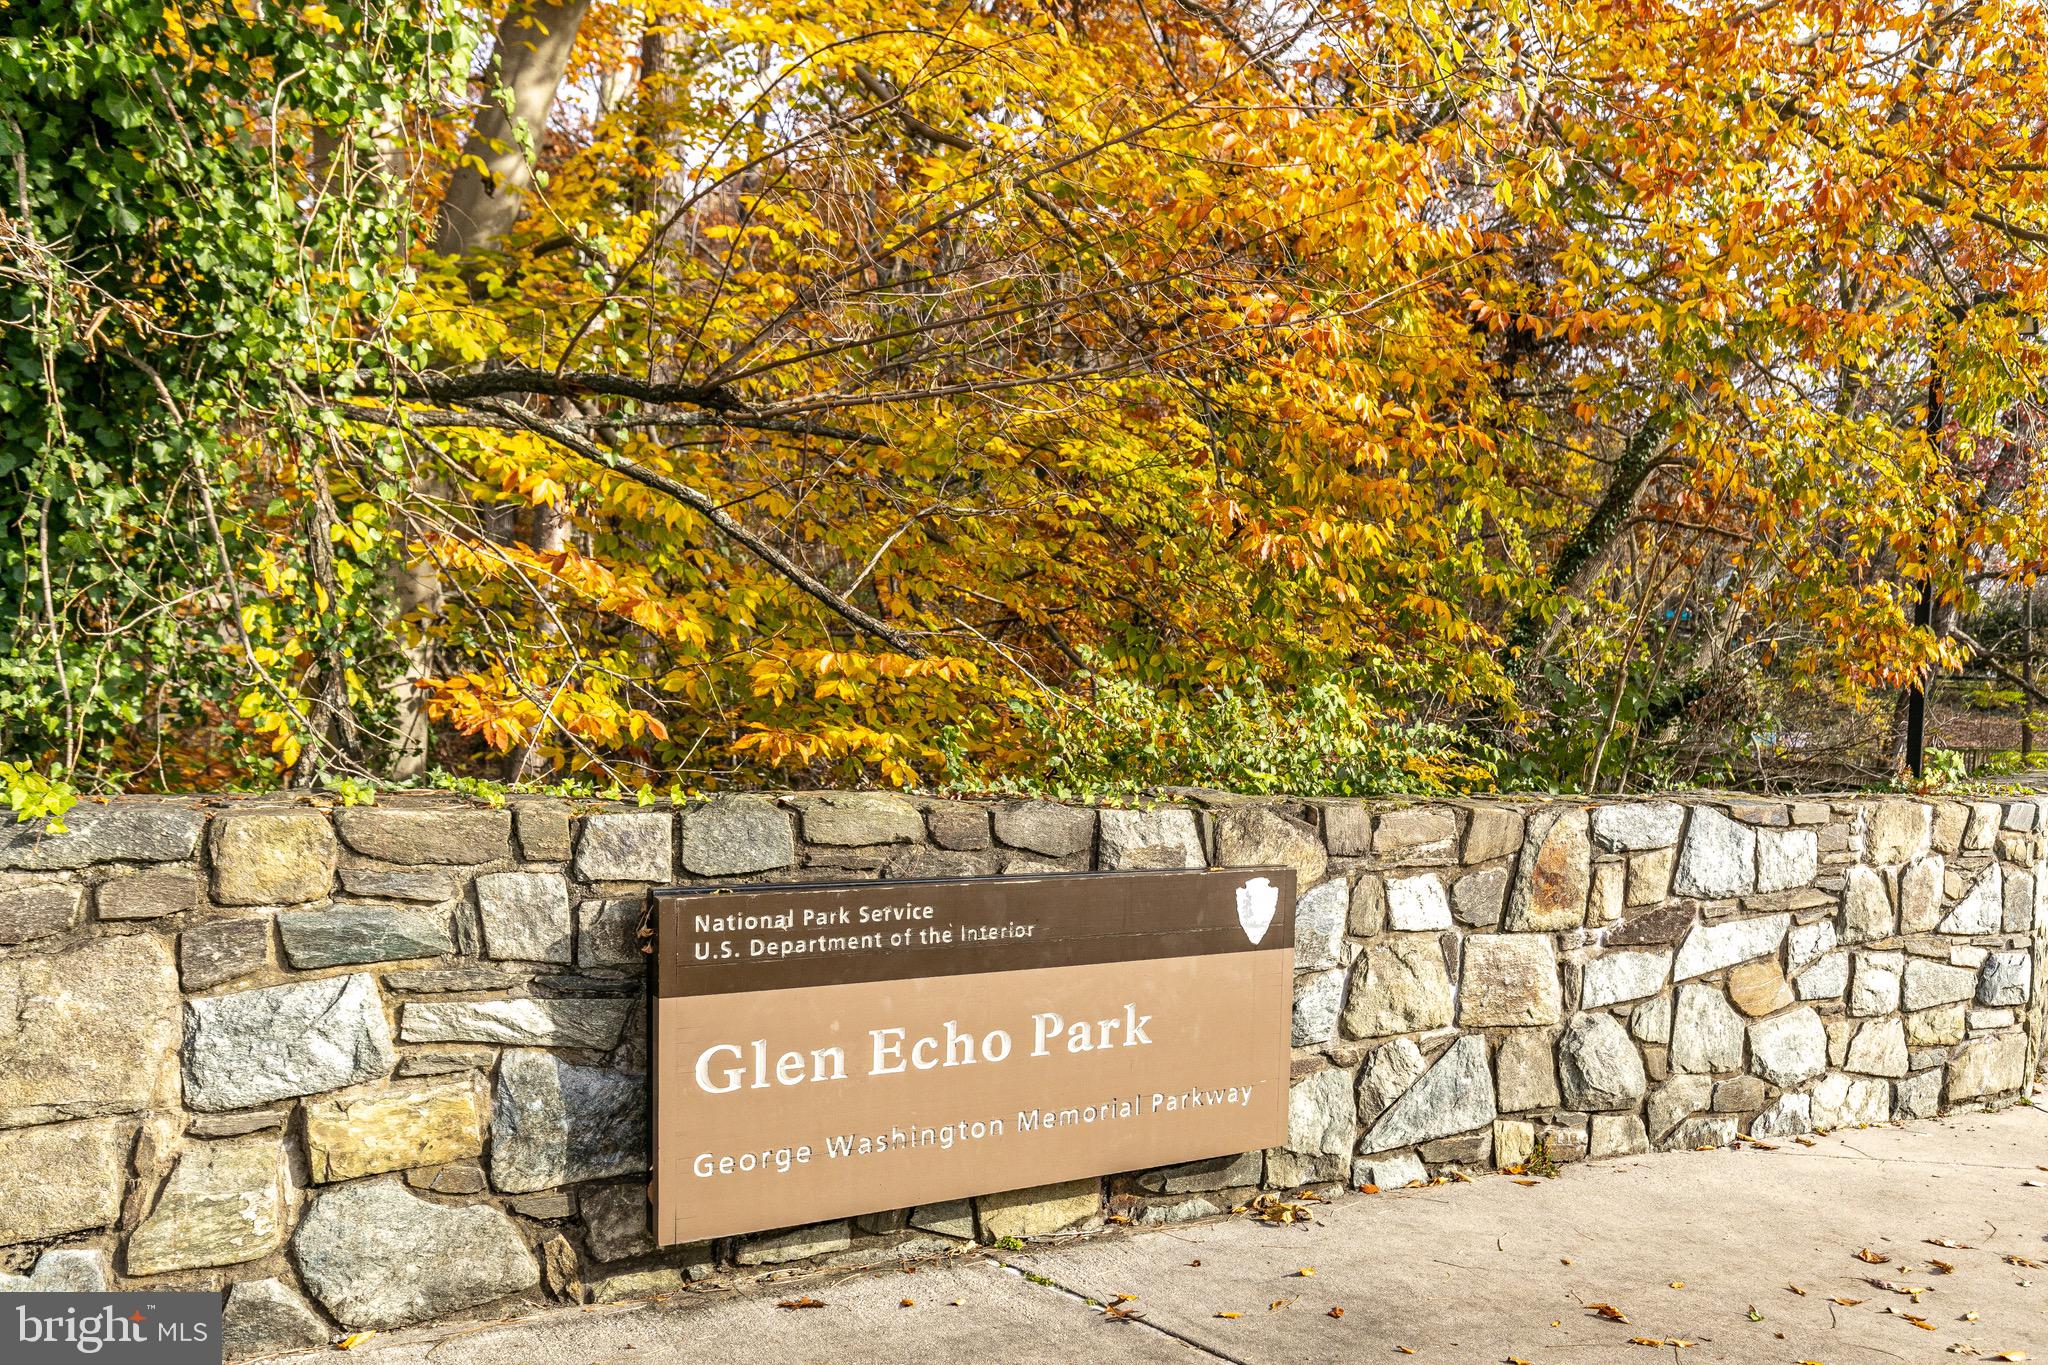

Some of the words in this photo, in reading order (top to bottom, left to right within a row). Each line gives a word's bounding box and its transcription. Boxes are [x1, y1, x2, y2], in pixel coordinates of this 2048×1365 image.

[695, 909, 794, 932] National
[803, 906, 850, 927] Park
[859, 903, 934, 923] Service
[695, 939, 740, 961] U.S.
[750, 933, 882, 958] Department
[890, 928, 912, 946] of
[920, 925, 952, 943] the
[961, 923, 1035, 942] Interior
[695, 1039, 848, 1094] Glen
[868, 1020, 1012, 1075] Echo
[1030, 1003, 1152, 1056] Park
[693, 1146, 812, 1177] George
[826, 1119, 1004, 1159] Washington
[1018, 1094, 1140, 1132] Memorial
[1152, 1085, 1252, 1112] Parkway
